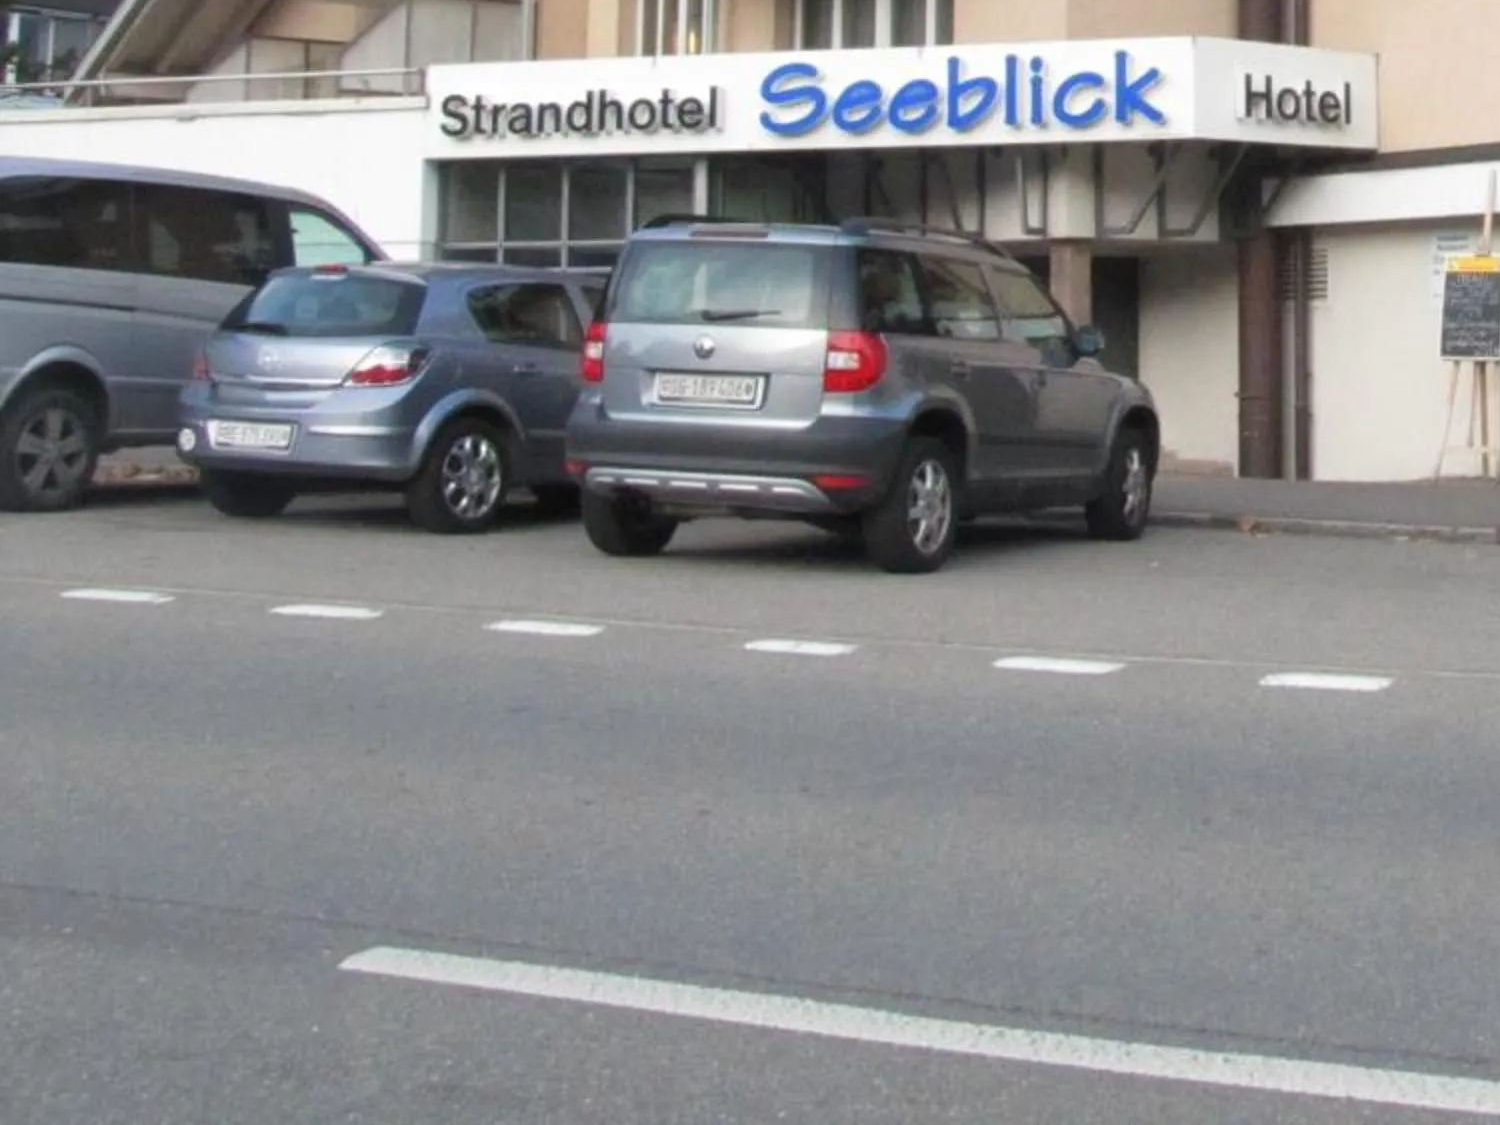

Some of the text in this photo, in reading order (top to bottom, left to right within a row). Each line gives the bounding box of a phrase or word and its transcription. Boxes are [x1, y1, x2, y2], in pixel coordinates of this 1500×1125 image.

[440, 52, 1164, 138] Strandhotel Seeblick
[1244, 74, 1352, 126] Hotel
